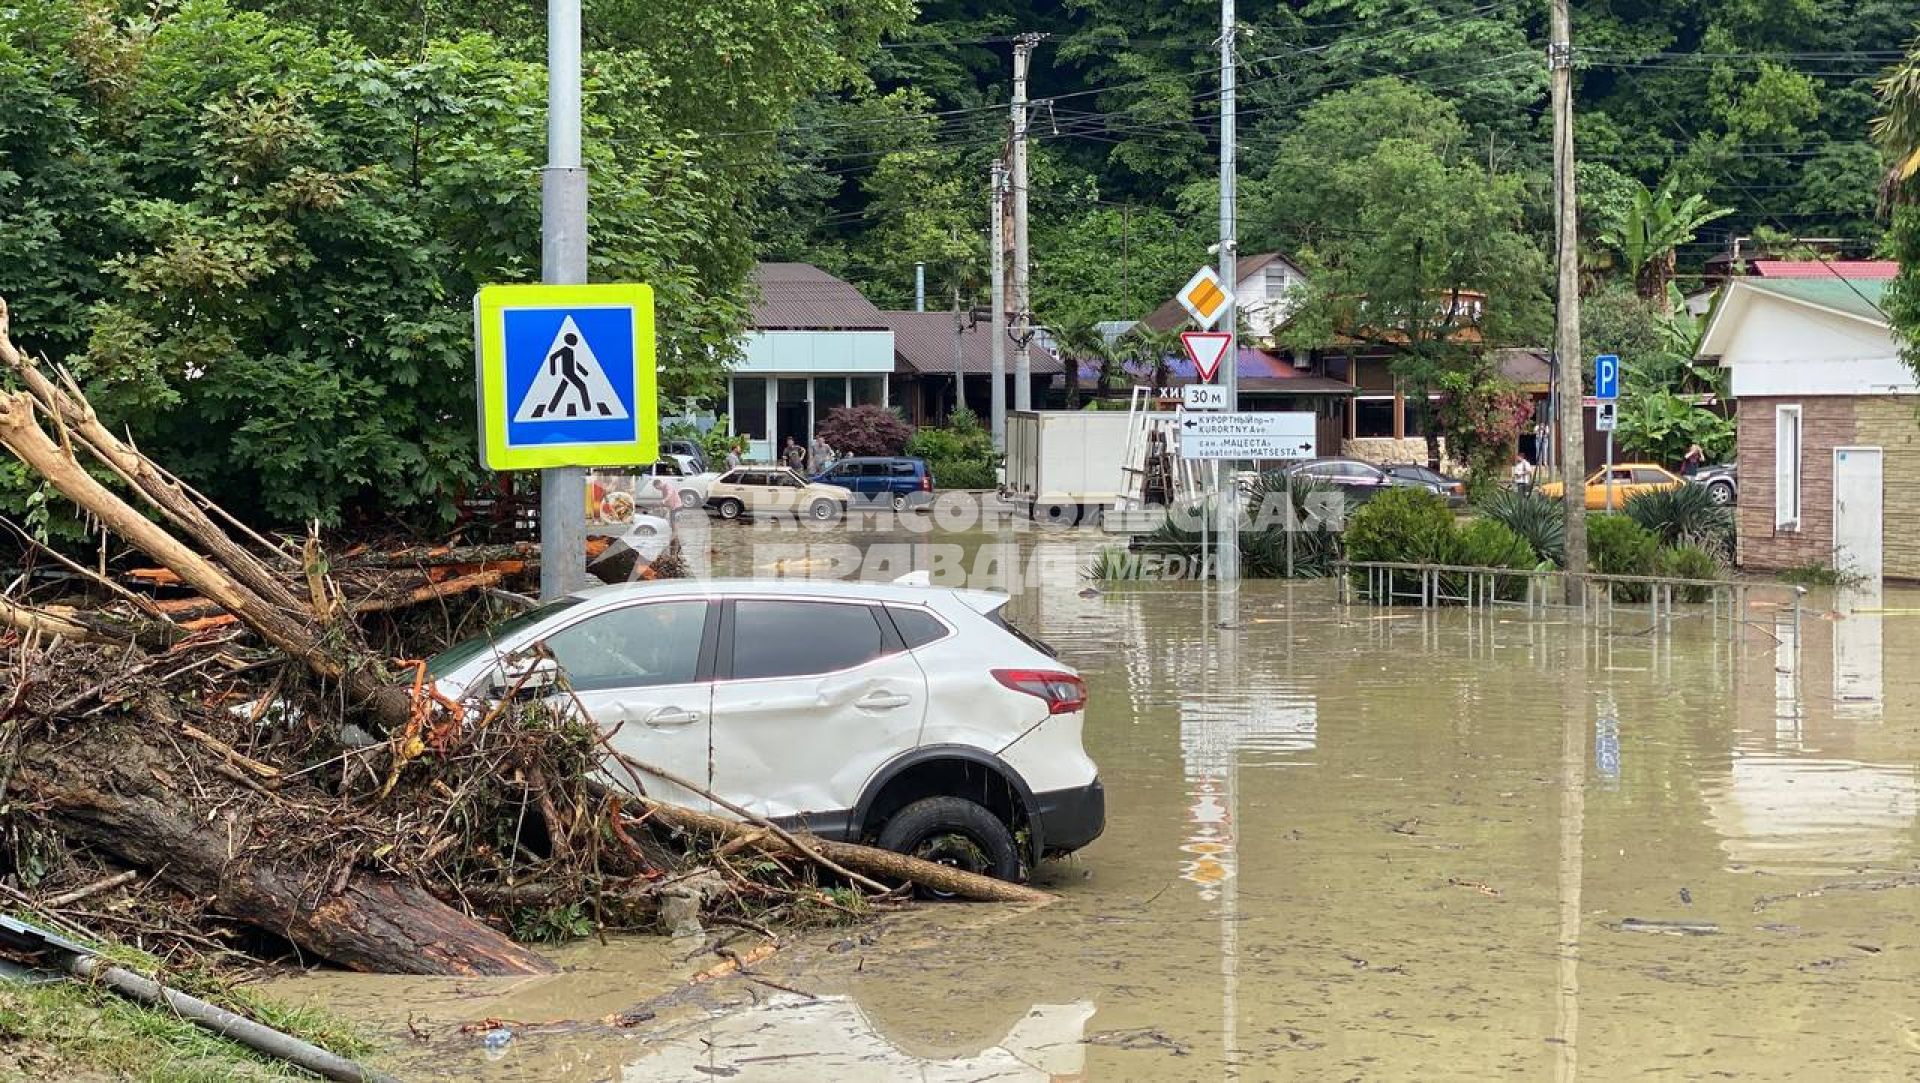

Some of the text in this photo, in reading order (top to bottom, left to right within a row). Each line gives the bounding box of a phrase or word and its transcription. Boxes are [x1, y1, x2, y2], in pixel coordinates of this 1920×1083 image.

[1160, 386, 1185, 399] ХИ
[1191, 389, 1221, 403] 30 м
[1198, 415, 1252, 424] КУРОРТНЫЙ
[1198, 425, 1249, 433] KURORTNY
[1199, 448, 1297, 456] sanatorium MATSESTA
